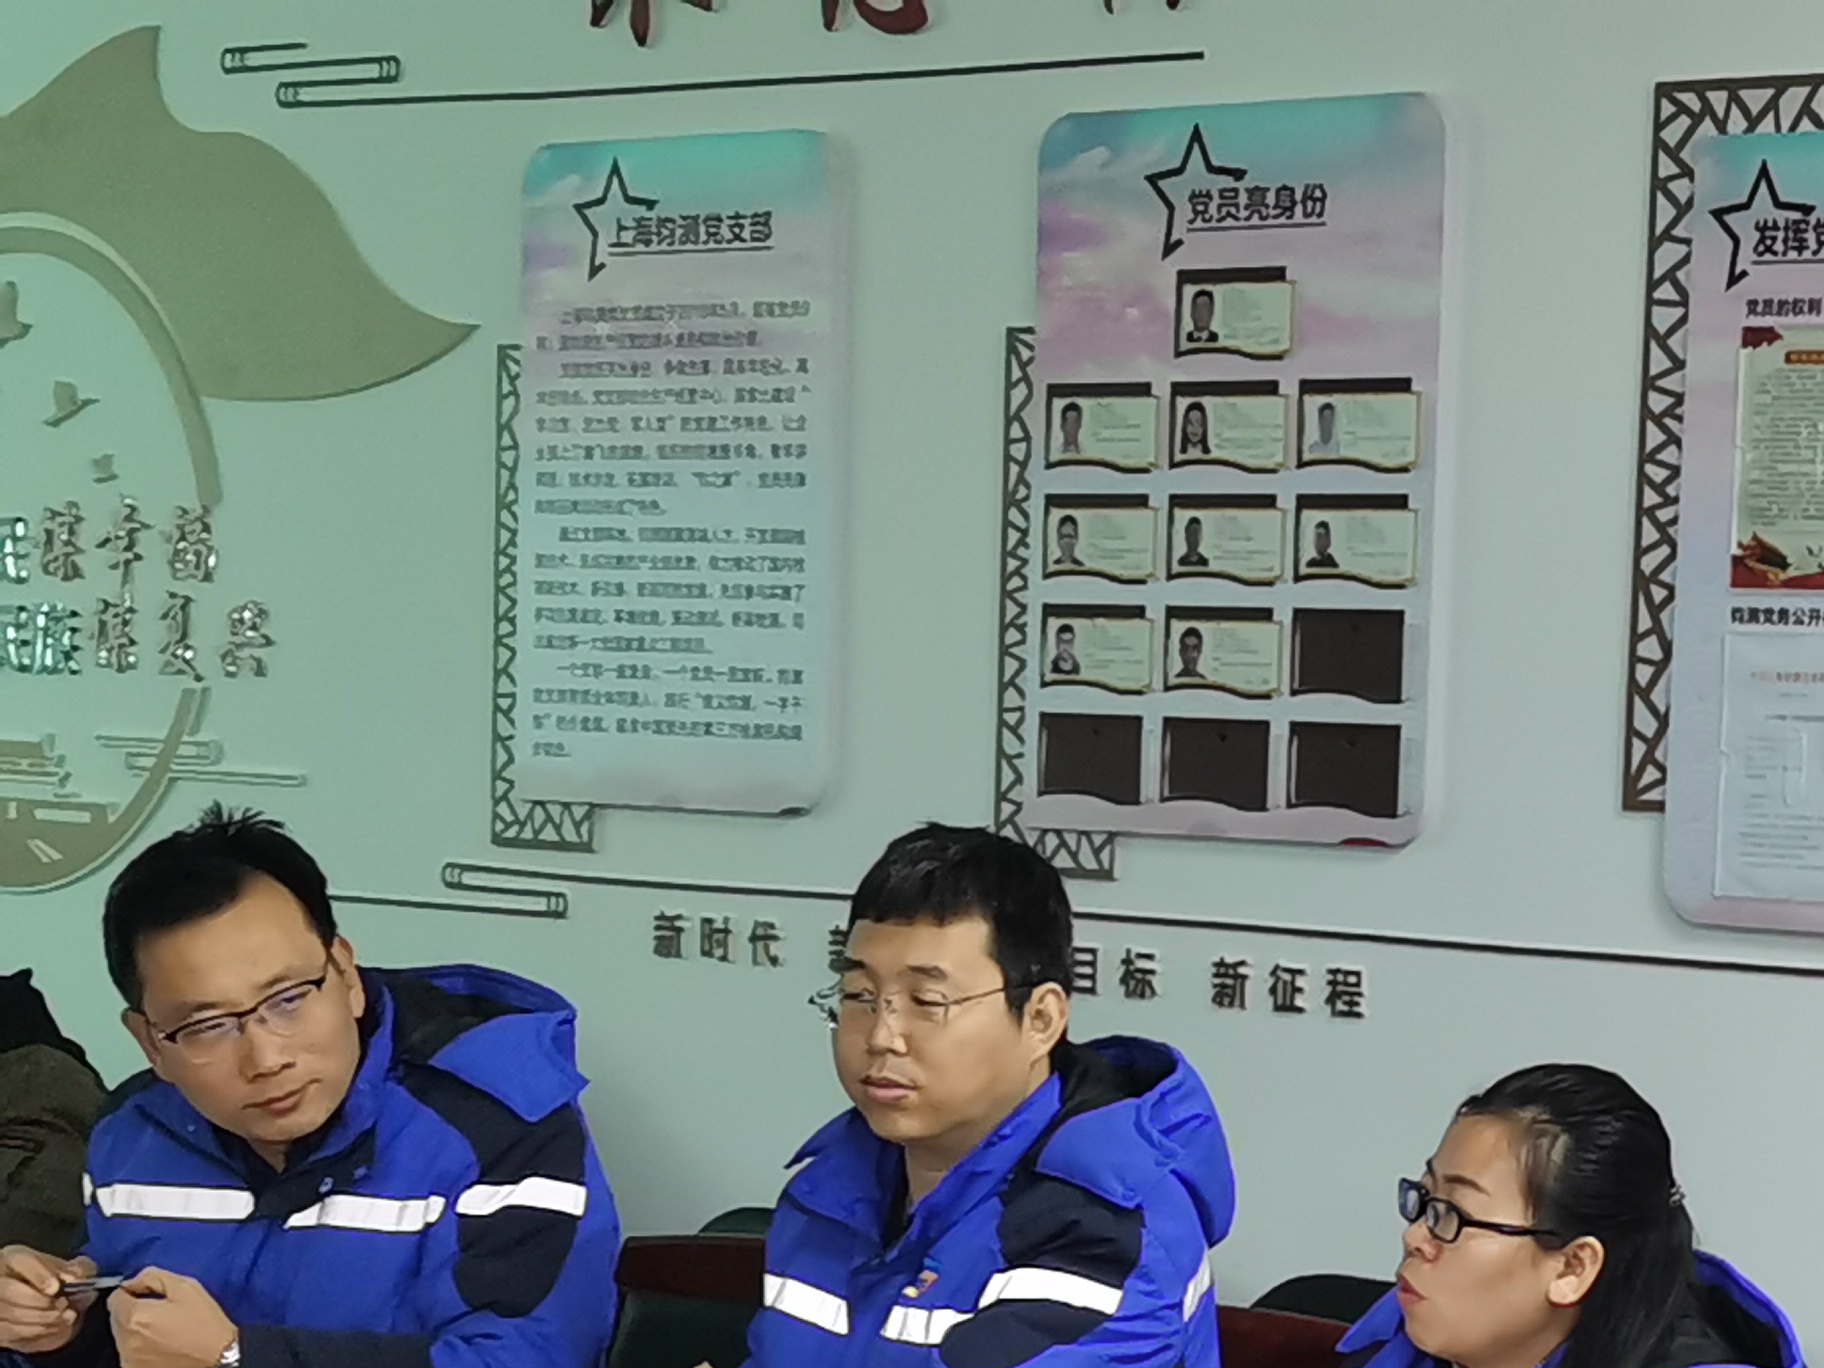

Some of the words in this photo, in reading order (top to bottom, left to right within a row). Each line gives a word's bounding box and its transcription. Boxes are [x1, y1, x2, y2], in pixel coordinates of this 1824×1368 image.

[1187, 183, 1328, 224] 党员亮身份
[651, 911, 785, 968] 新时代
[1211, 957, 1368, 1019] 新征程
